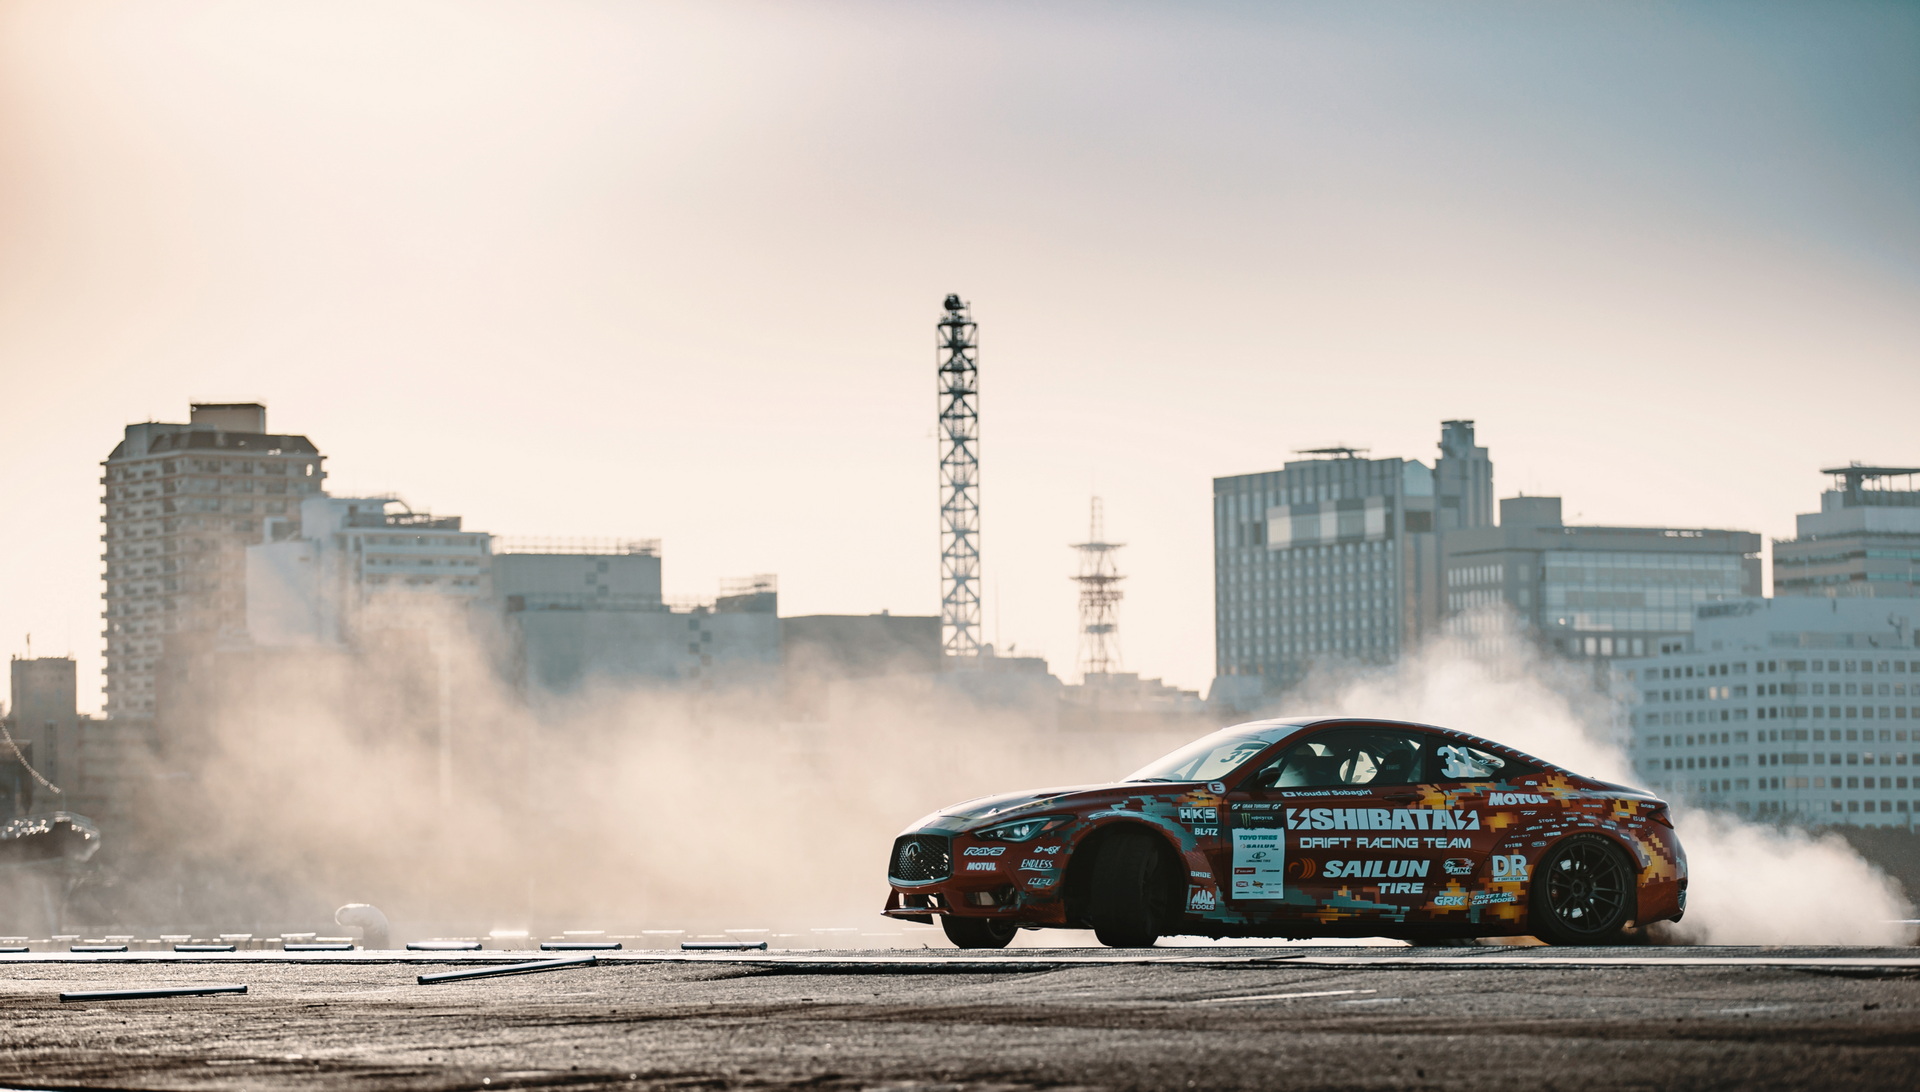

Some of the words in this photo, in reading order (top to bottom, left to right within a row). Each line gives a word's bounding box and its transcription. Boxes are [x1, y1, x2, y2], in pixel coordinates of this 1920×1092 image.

[1220, 750, 1255, 764] 31
[1437, 746, 1476, 778] 31
[1331, 789, 1373, 797] Sobagiri
[1488, 792, 1549, 806] MOTUL
[1179, 808, 1217, 820] HKS
[1310, 807, 1457, 830] SHIBATA
[1299, 836, 1351, 848] DRIFT
[1356, 836, 1418, 848] RACING
[1424, 836, 1472, 848] TEAM
[963, 847, 1007, 856] RAYS
[966, 862, 997, 871] MOTUL
[1020, 859, 1054, 869] ENDLESS
[1322, 860, 1431, 878] SAILUN
[1491, 854, 1529, 876] DR
[1377, 882, 1425, 894] TIRE
[1191, 889, 1216, 905] MAC
[1434, 896, 1465, 906] GRK
